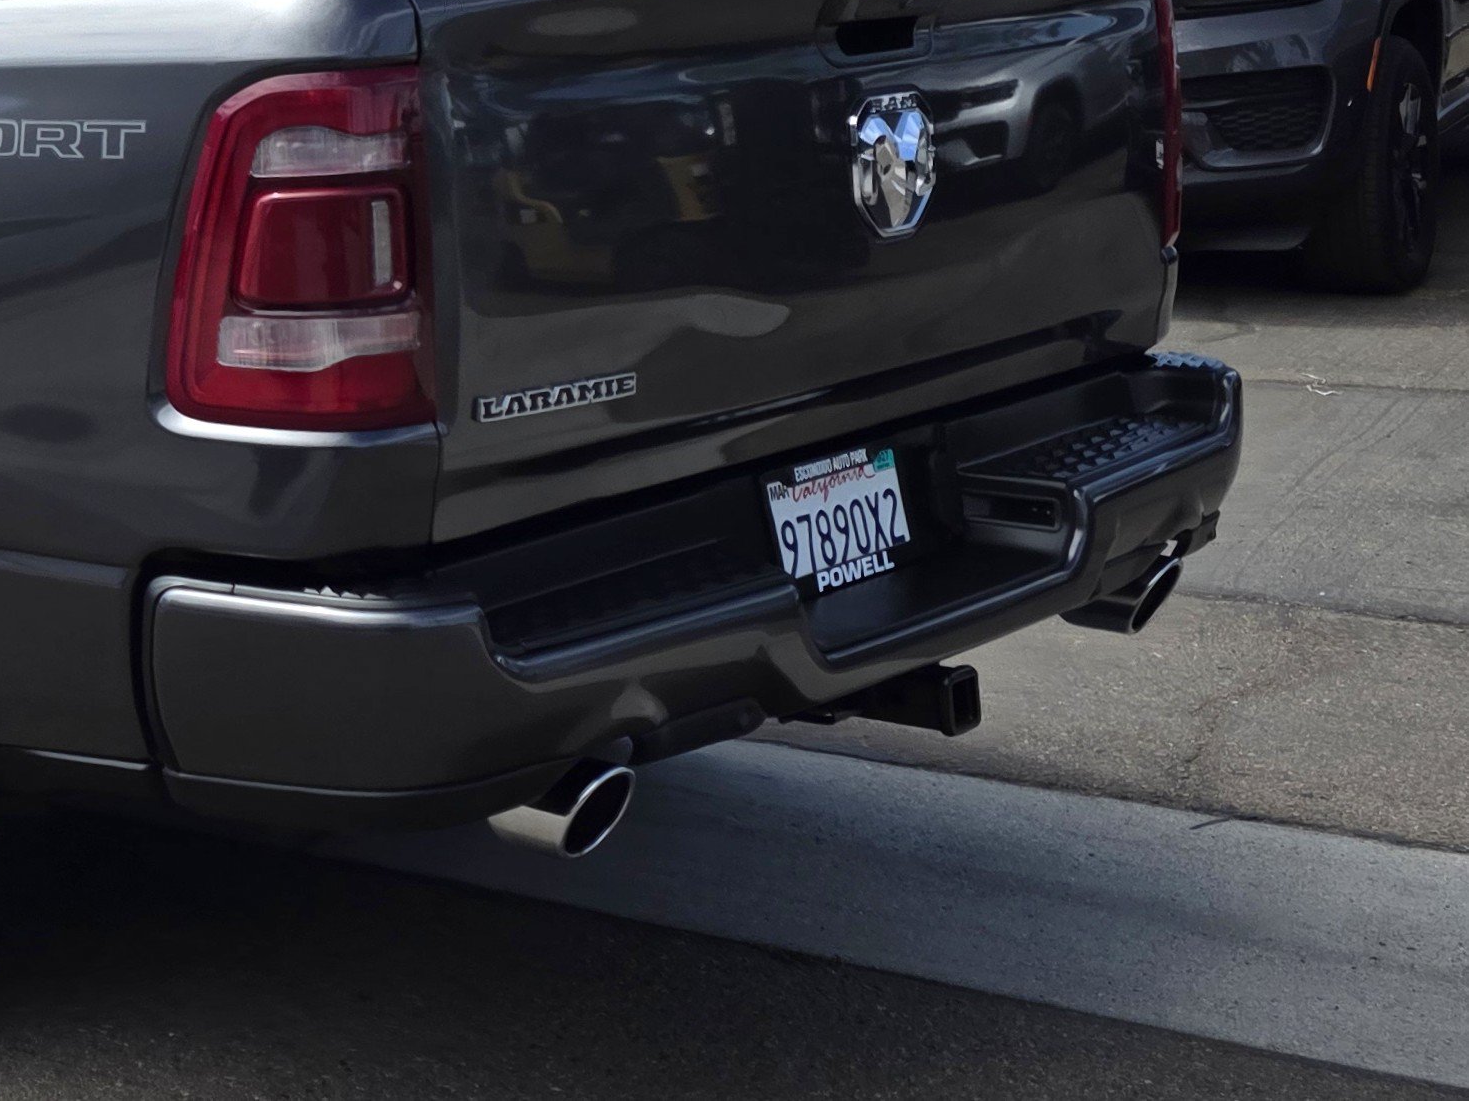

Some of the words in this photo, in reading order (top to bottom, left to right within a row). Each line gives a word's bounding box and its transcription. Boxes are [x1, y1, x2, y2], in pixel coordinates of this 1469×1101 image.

[870, 95, 918, 113] RAM
[478, 372, 636, 423] LARAMIE
[832, 453, 851, 470] AUTO
[850, 448, 869, 465] PARK
[792, 465, 875, 503] California
[781, 488, 906, 578] 97890X2
[817, 551, 895, 592] POWELL
